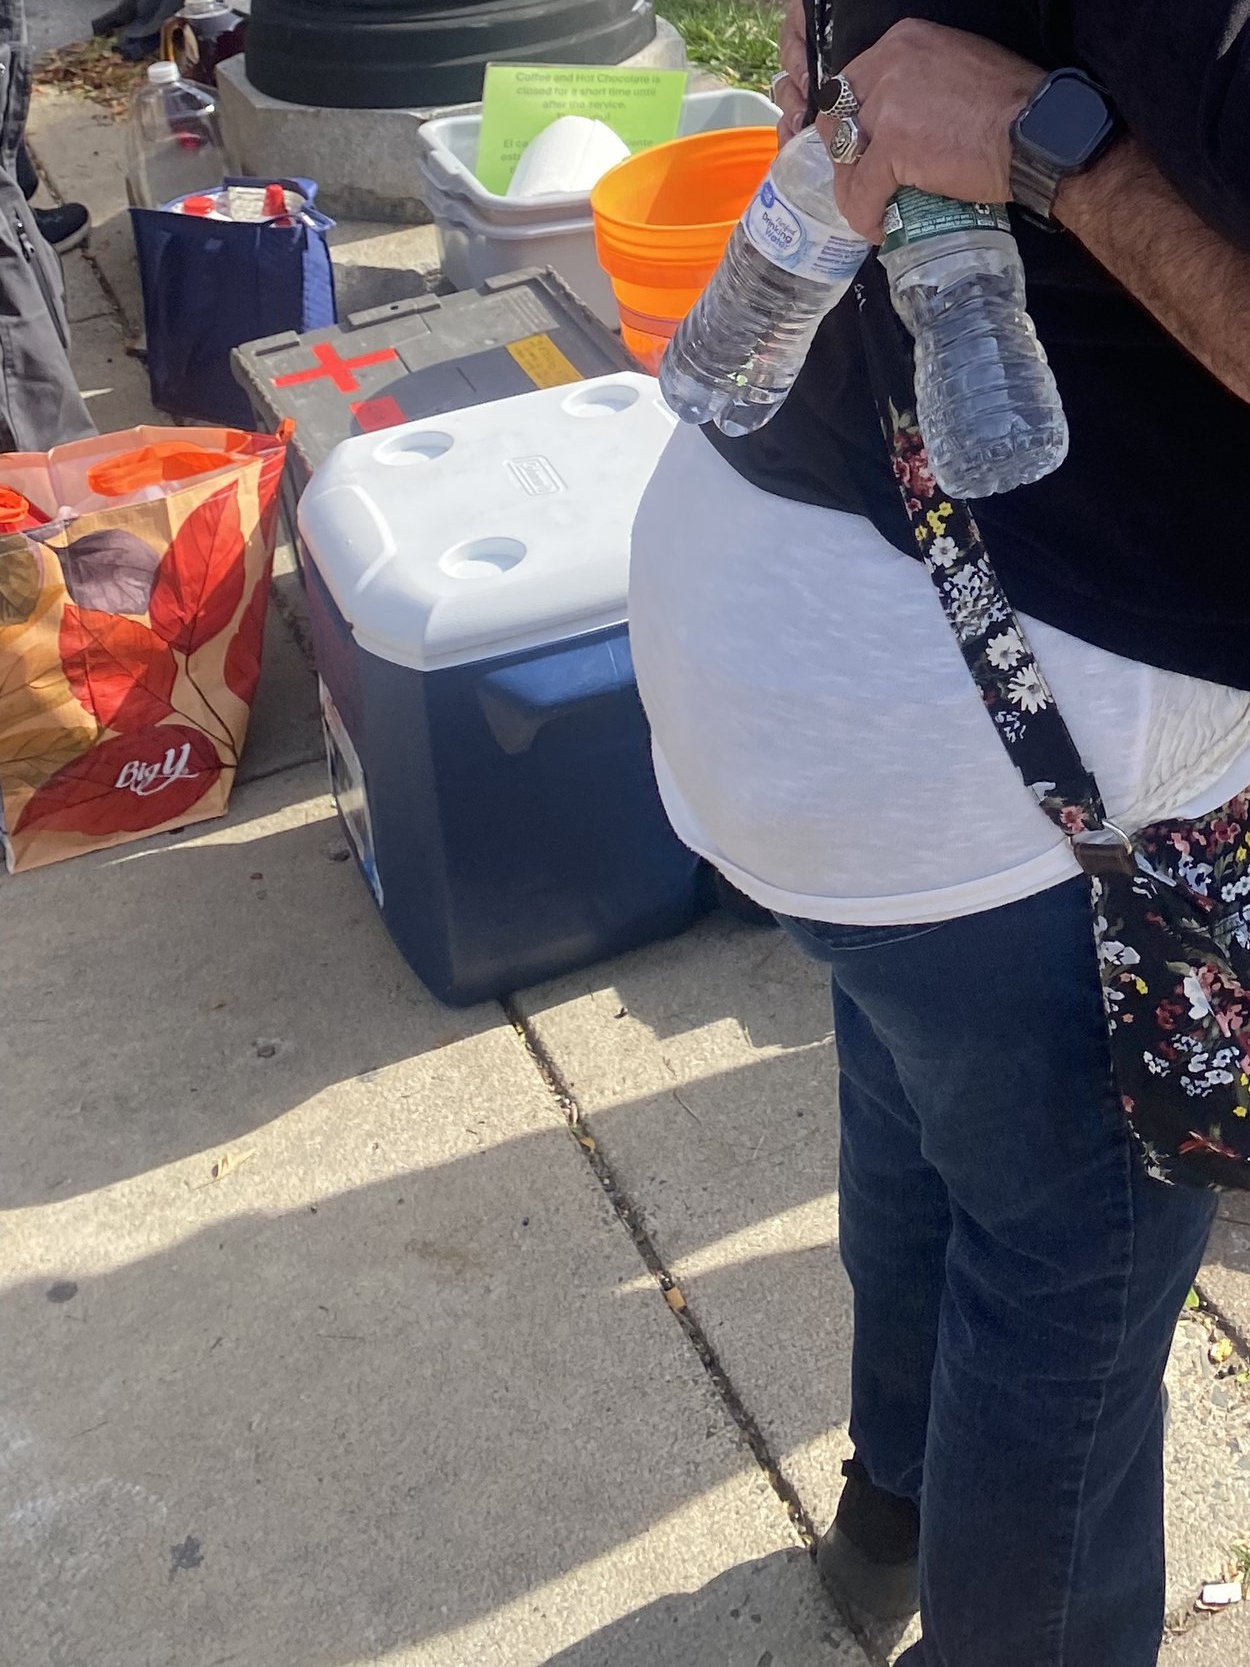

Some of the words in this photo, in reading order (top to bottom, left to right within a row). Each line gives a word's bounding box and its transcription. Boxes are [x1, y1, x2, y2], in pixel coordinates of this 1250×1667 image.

[515, 72, 551, 82] Coffee
[553, 73, 573, 82] and
[575, 73, 594, 82] Hot
[597, 74, 649, 84] Chocolate
[651, 75, 661, 84] is
[516, 86, 552, 95] closed
[554, 87, 568, 95] for
[580, 87, 606, 96] short
[608, 88, 631, 96] time
[633, 87, 656, 96] until
[542, 100, 566, 109] after
[569, 101, 585, 109] the
[762, 211, 792, 244] Drinking
[765, 227, 789, 250] Water
[114, 760, 161, 796] Big
